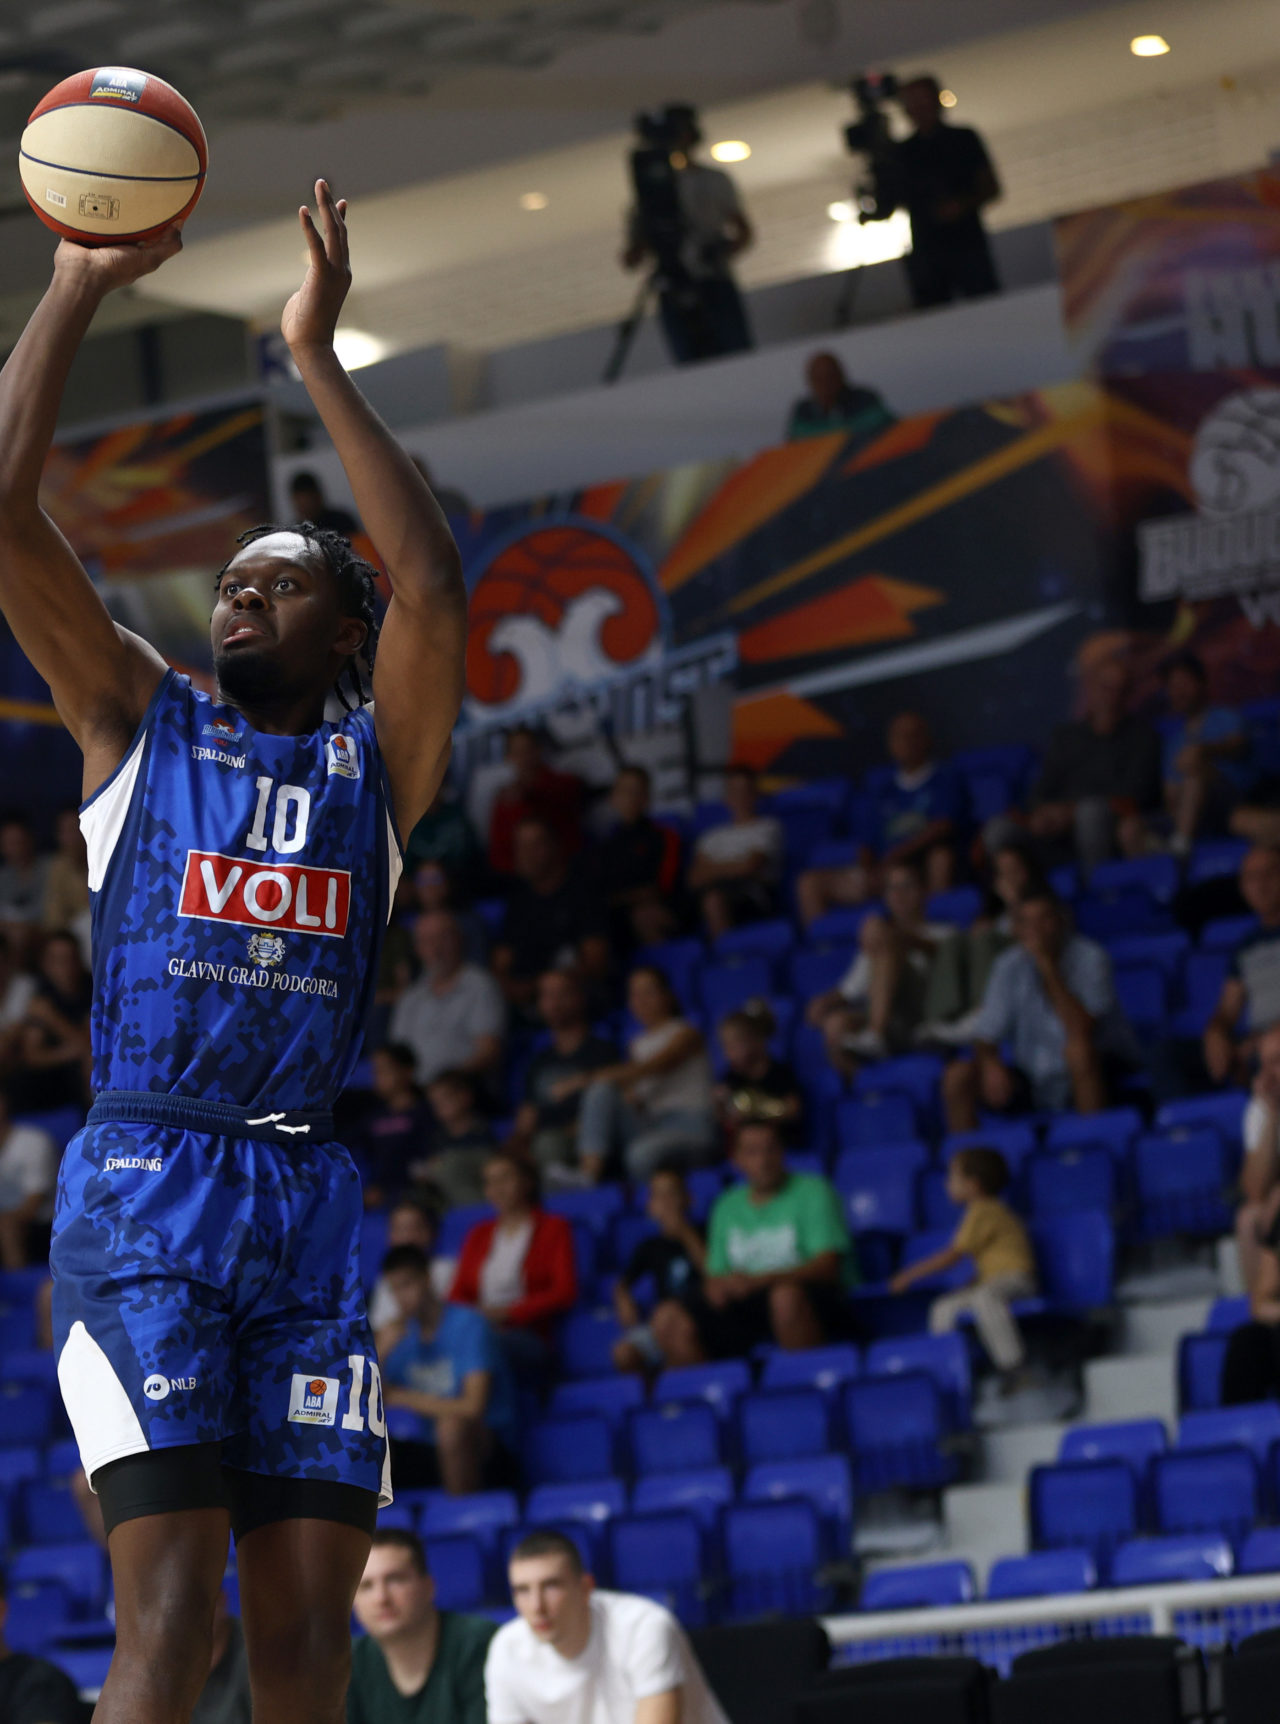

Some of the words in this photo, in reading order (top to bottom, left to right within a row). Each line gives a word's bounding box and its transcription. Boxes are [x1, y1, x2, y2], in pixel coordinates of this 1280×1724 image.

[191, 745, 246, 769] SPALDING
[246, 776, 311, 854] 10
[200, 860, 337, 930] VOLI
[168, 958, 226, 982] GLAVNI
[228, 966, 270, 988] GRAD
[103, 1157, 163, 1172] SPALDING
[170, 1377, 197, 1391] NLB
[342, 1354, 385, 1438] 10
[305, 1395, 322, 1408] ABA
[293, 1409, 332, 1419] ADMIRAL
